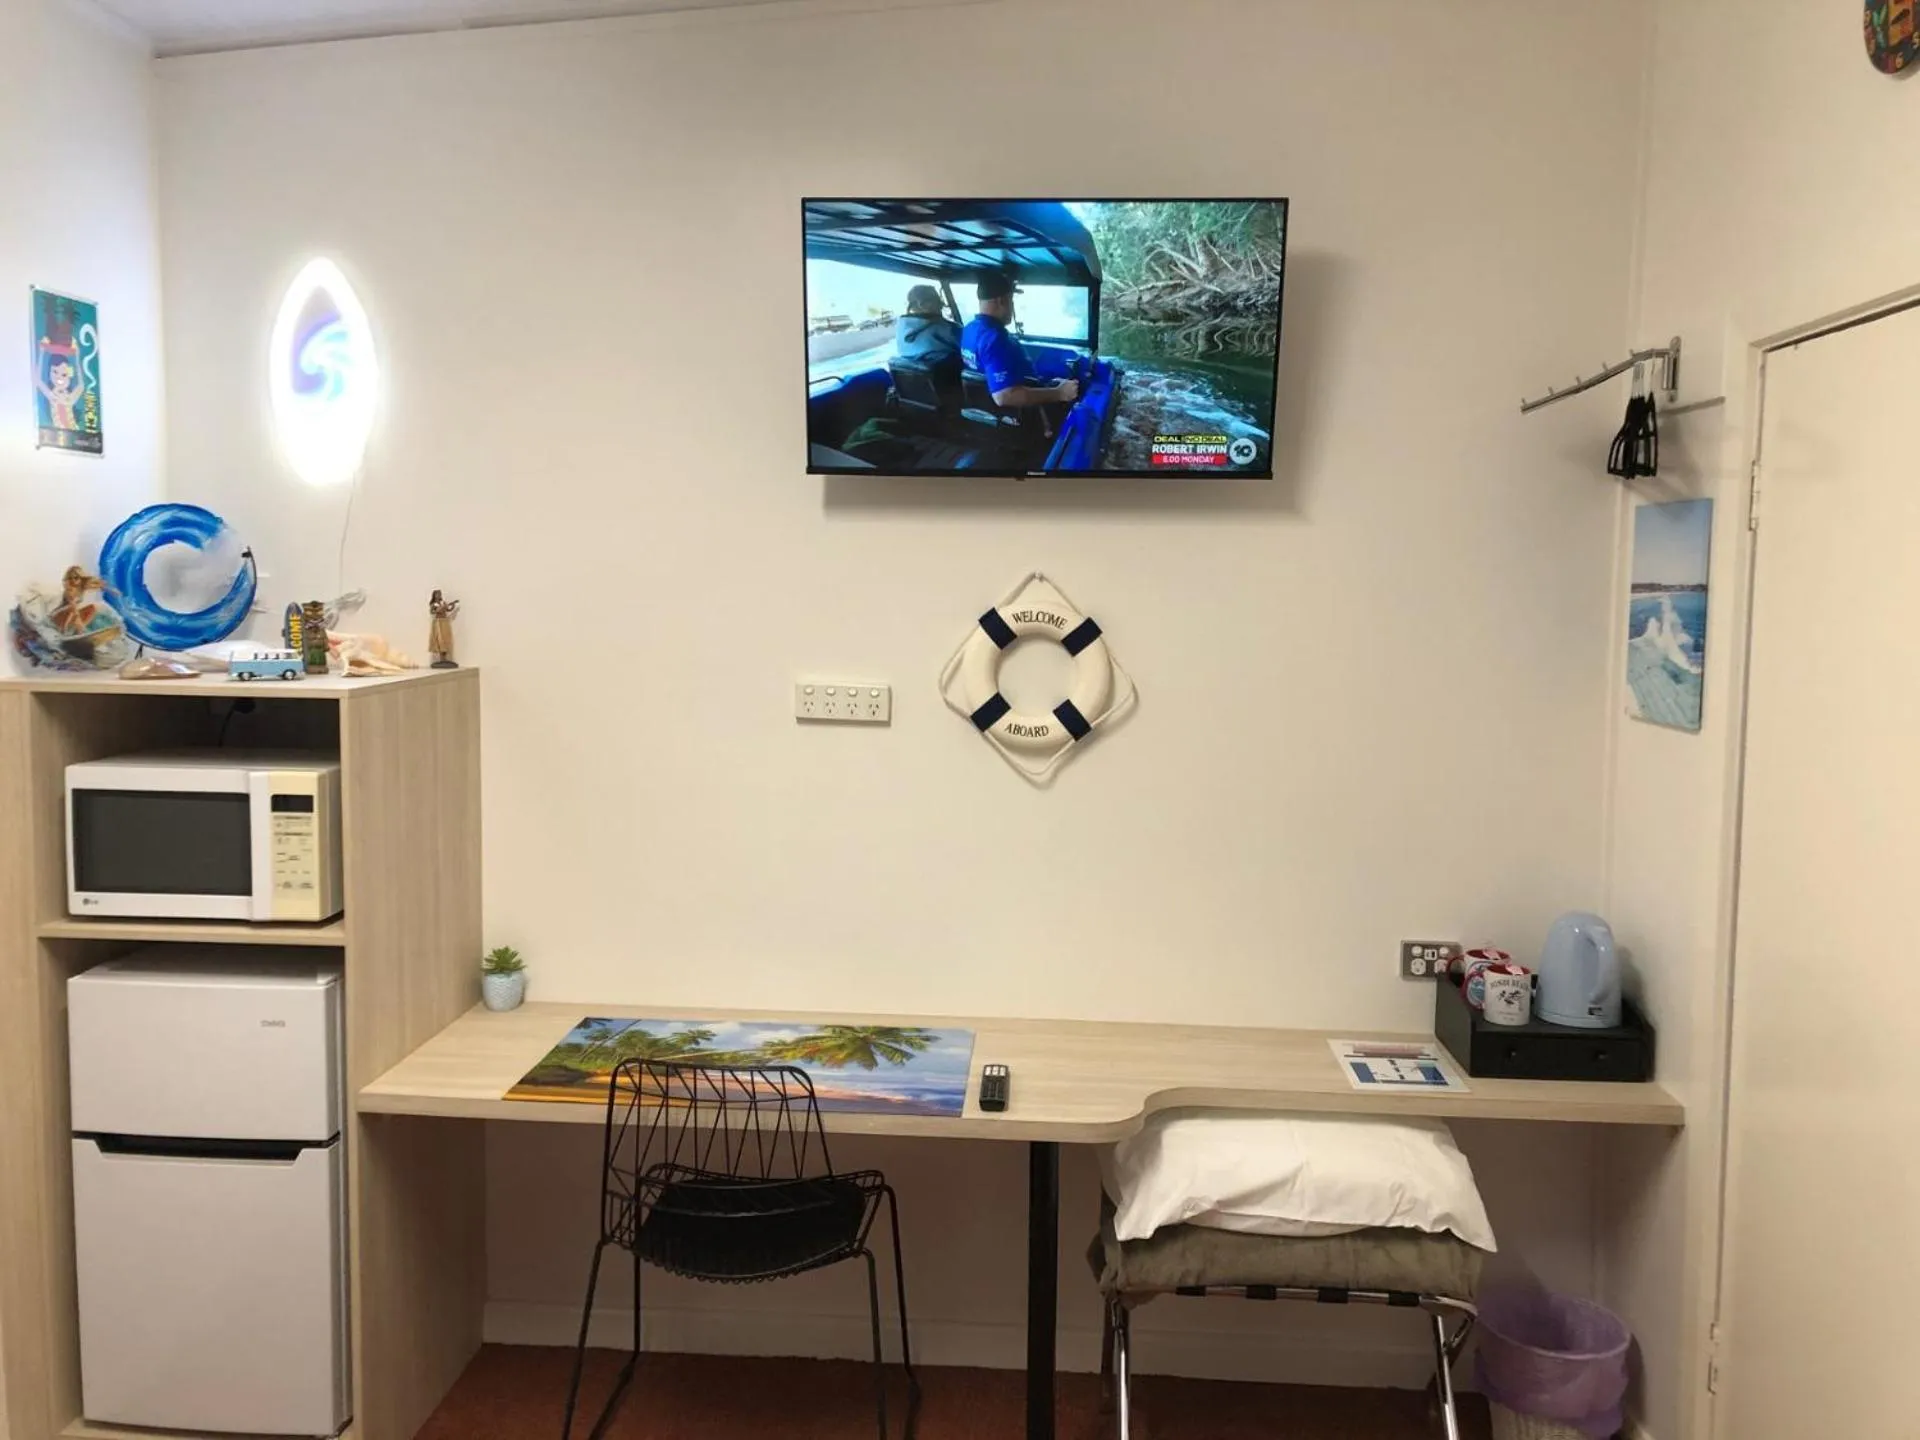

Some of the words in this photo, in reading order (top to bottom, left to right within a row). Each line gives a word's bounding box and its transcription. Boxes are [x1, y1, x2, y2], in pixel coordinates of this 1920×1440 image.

[1152, 444, 1195, 454] ROBERT
[1196, 444, 1228, 454] IRWIN
[1182, 455, 1215, 463] MONDAY
[1011, 610, 1068, 630] WELCOME
[1004, 723, 1049, 738] ABOARD
